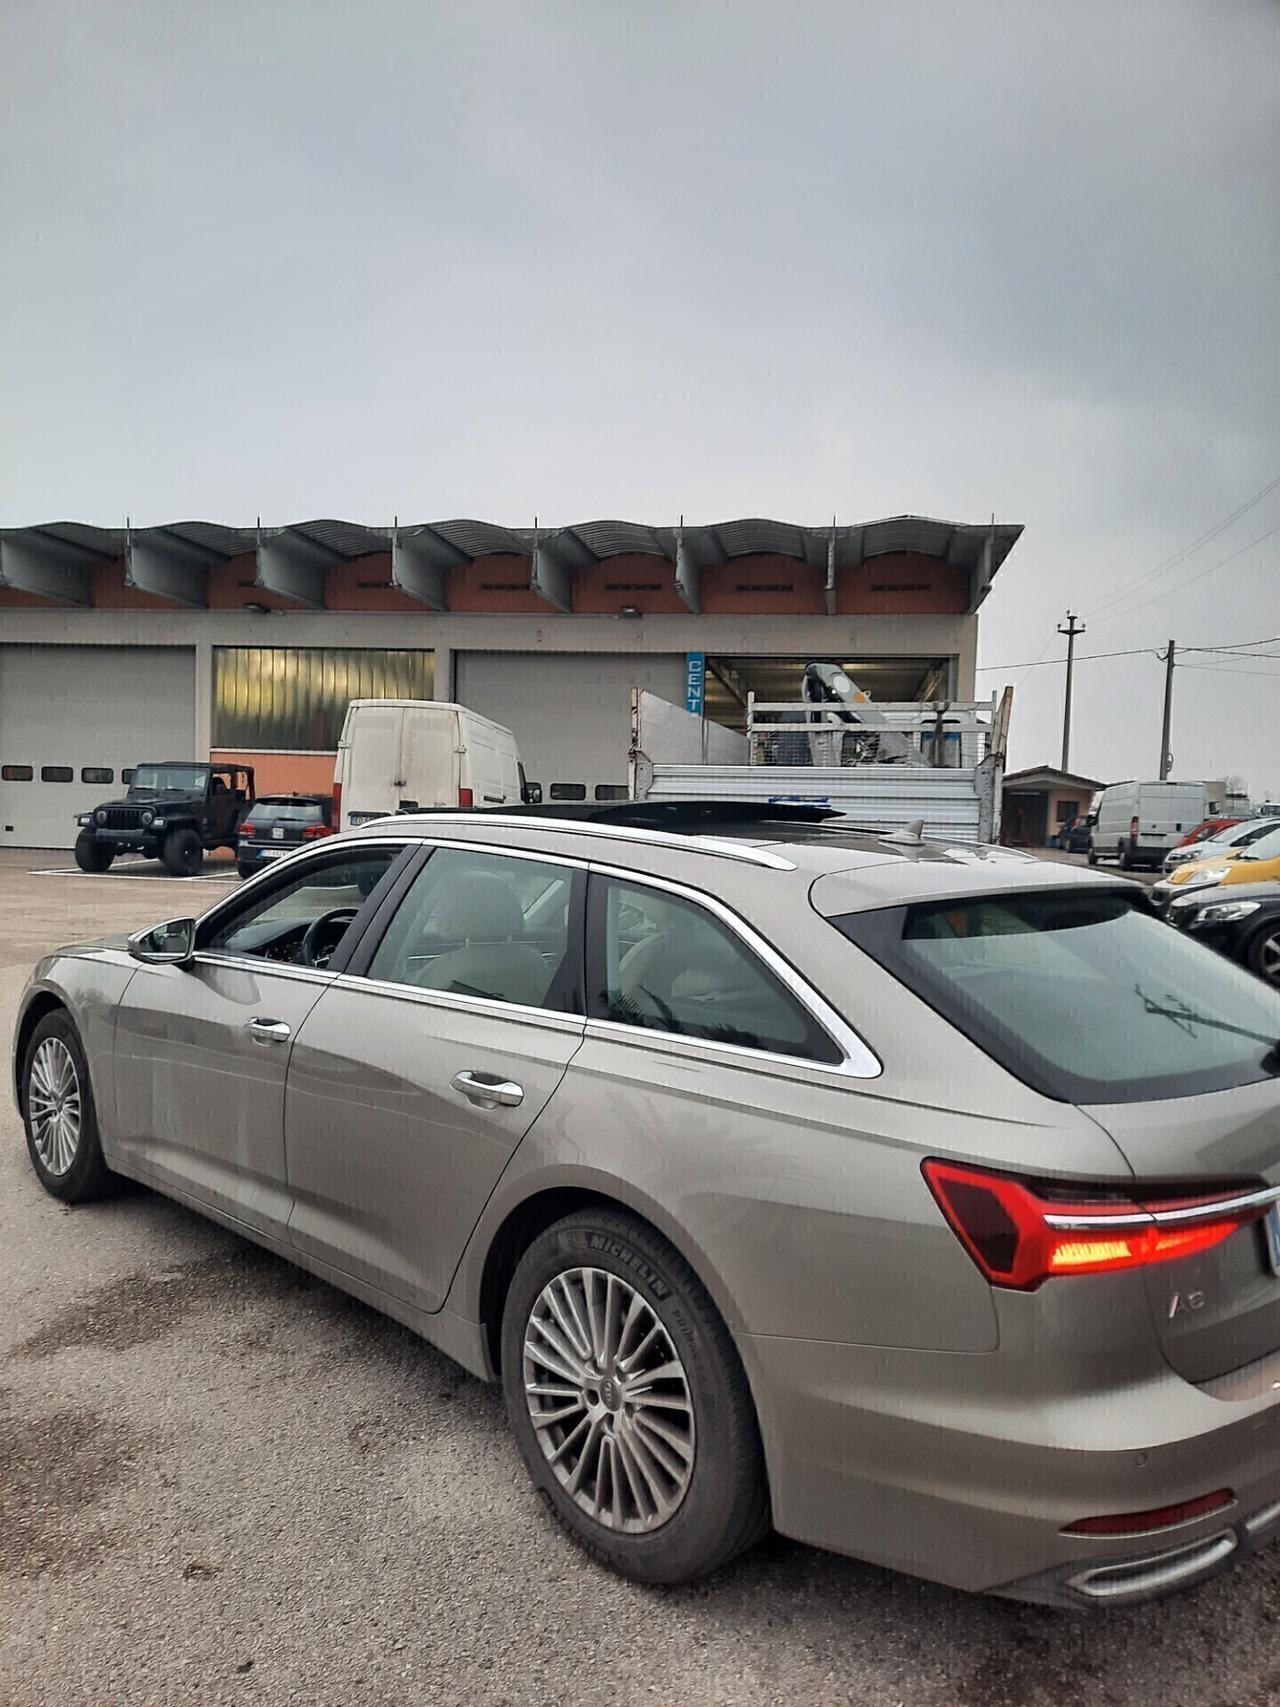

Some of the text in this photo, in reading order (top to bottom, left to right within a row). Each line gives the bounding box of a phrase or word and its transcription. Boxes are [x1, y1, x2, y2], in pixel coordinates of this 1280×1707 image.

[687, 660, 702, 716] CENT
[588, 1231, 673, 1301] MICHELIN
[1169, 1292, 1205, 1318] A6
